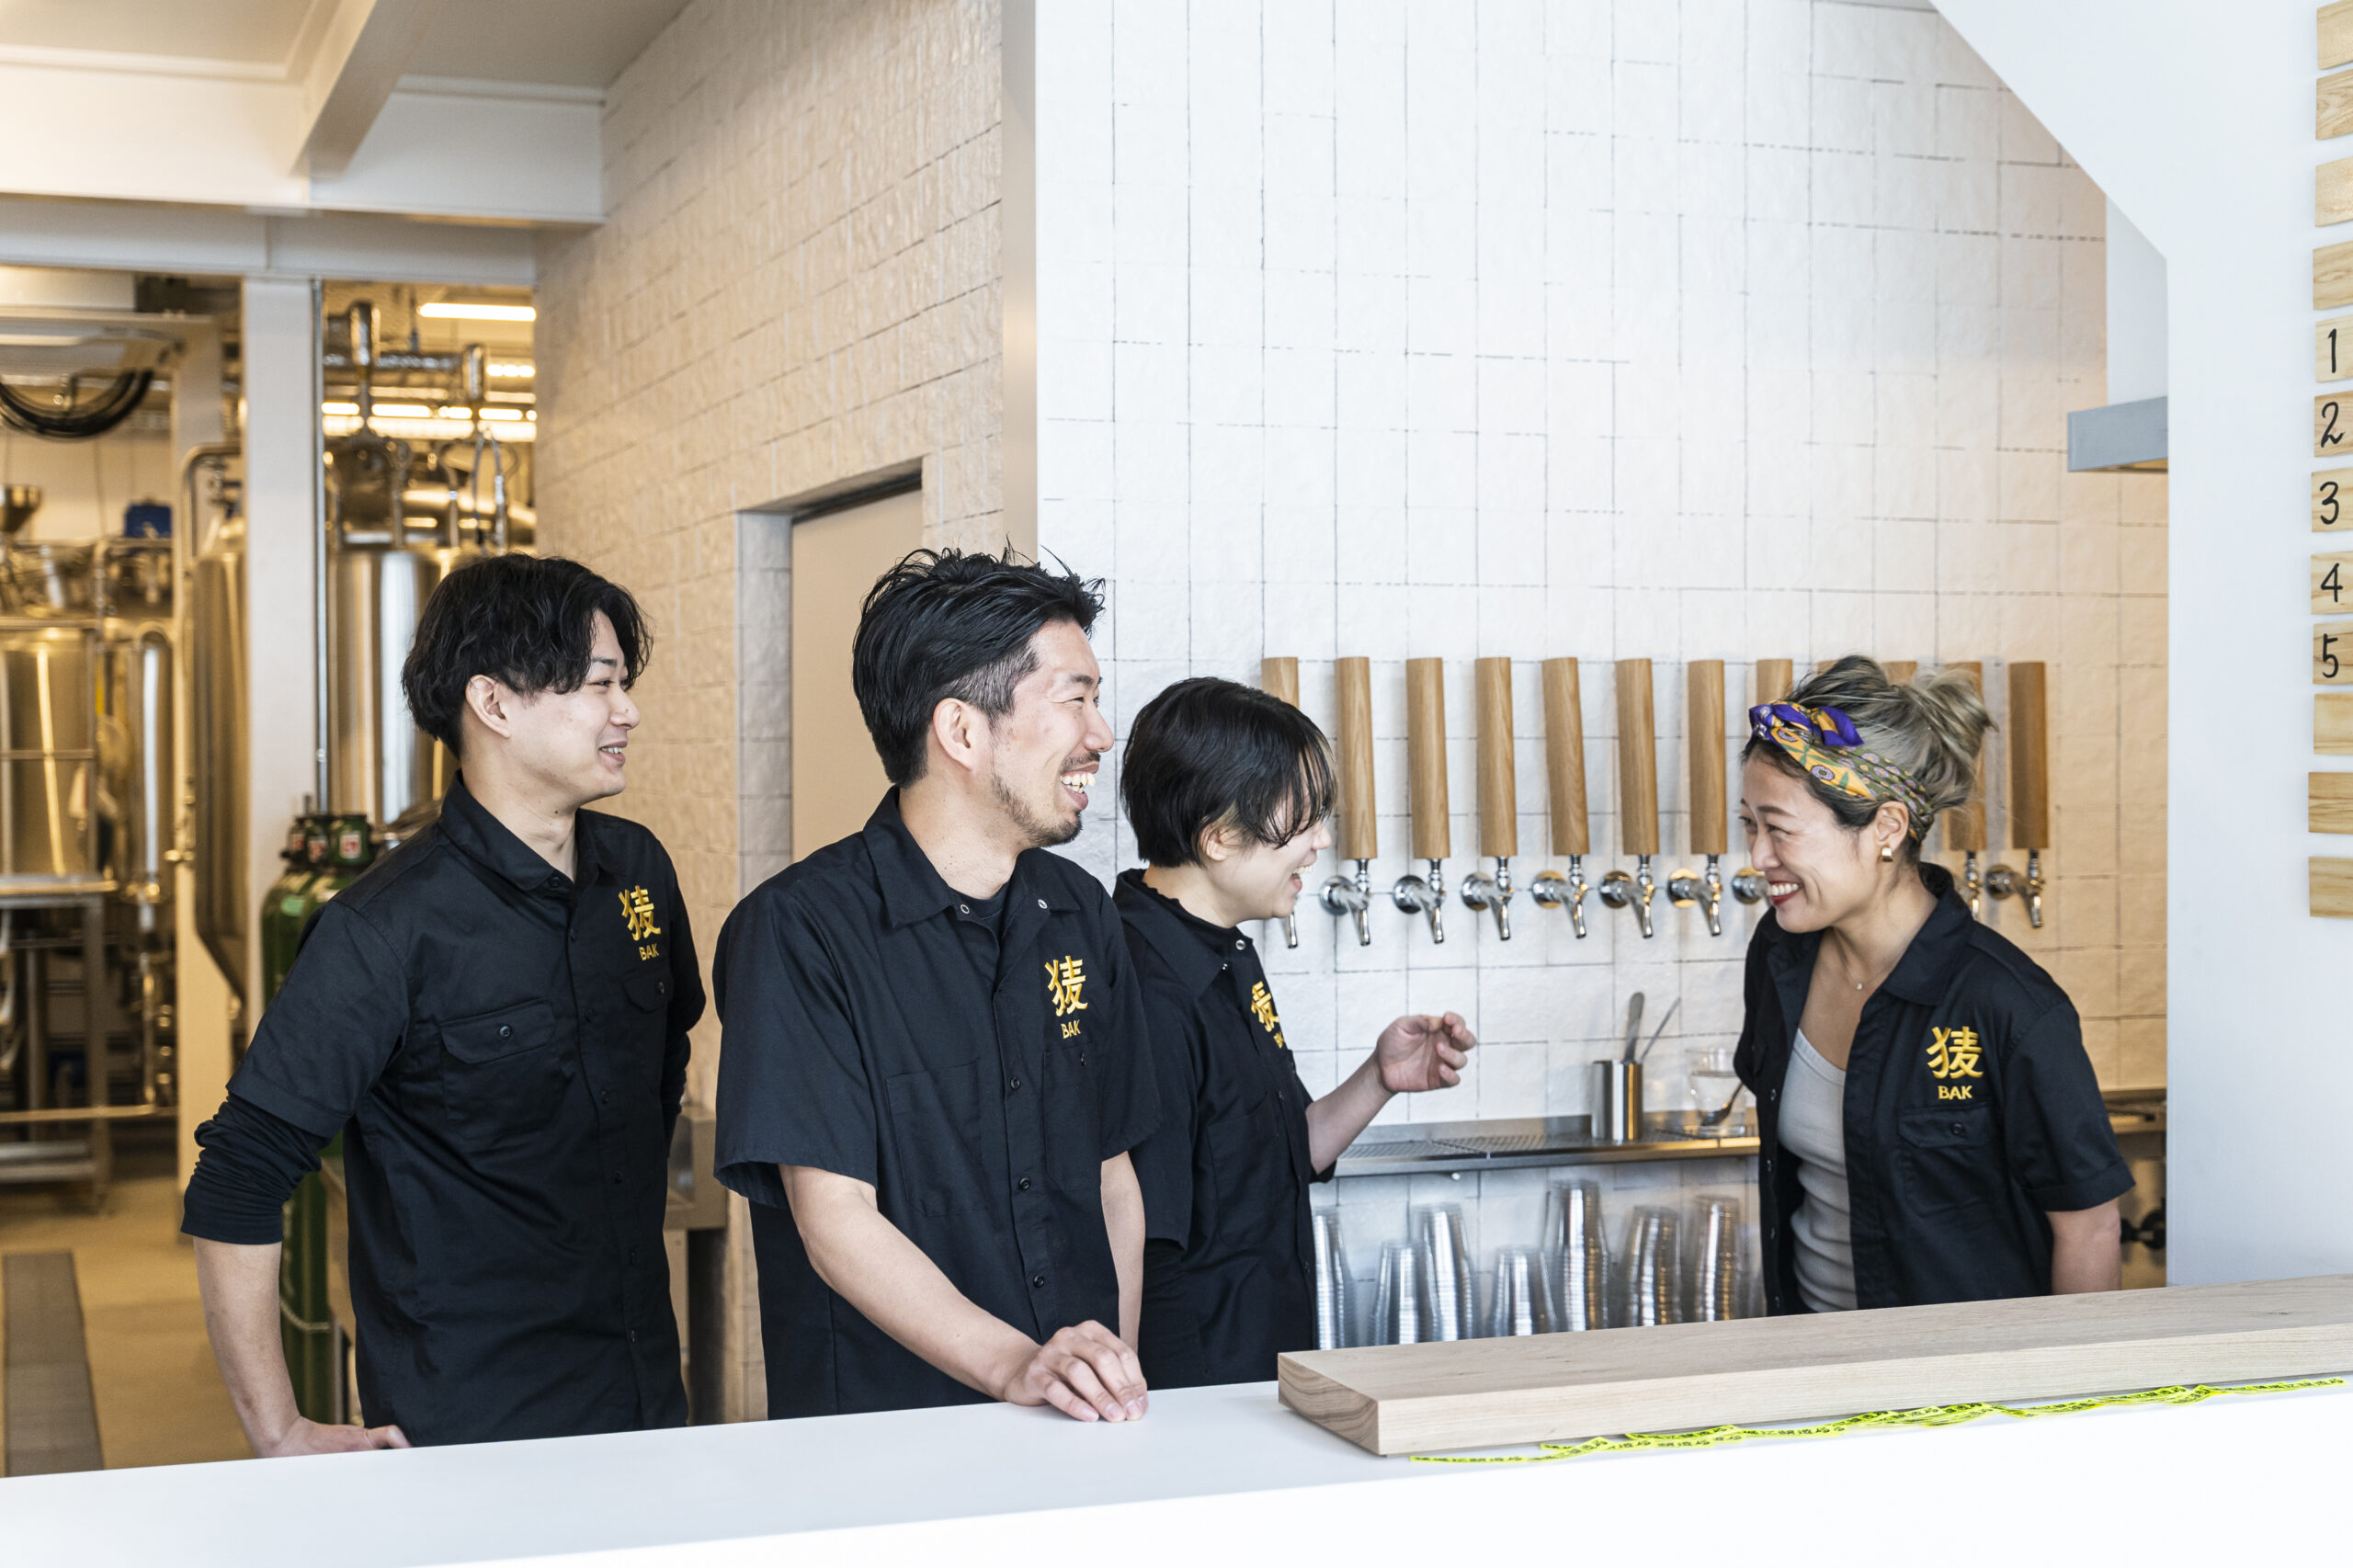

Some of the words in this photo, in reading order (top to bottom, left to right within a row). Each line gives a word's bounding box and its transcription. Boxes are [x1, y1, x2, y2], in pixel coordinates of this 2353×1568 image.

[2327, 328, 2337, 373] 1
[2321, 402, 2345, 448] 2
[2319, 481, 2339, 525] 3
[2320, 562, 2343, 603] 4
[2322, 633, 2338, 678] 5
[639, 943, 660, 961] BAK
[1061, 1019, 1082, 1039] BAK
[1938, 1085, 1973, 1101] BAK
